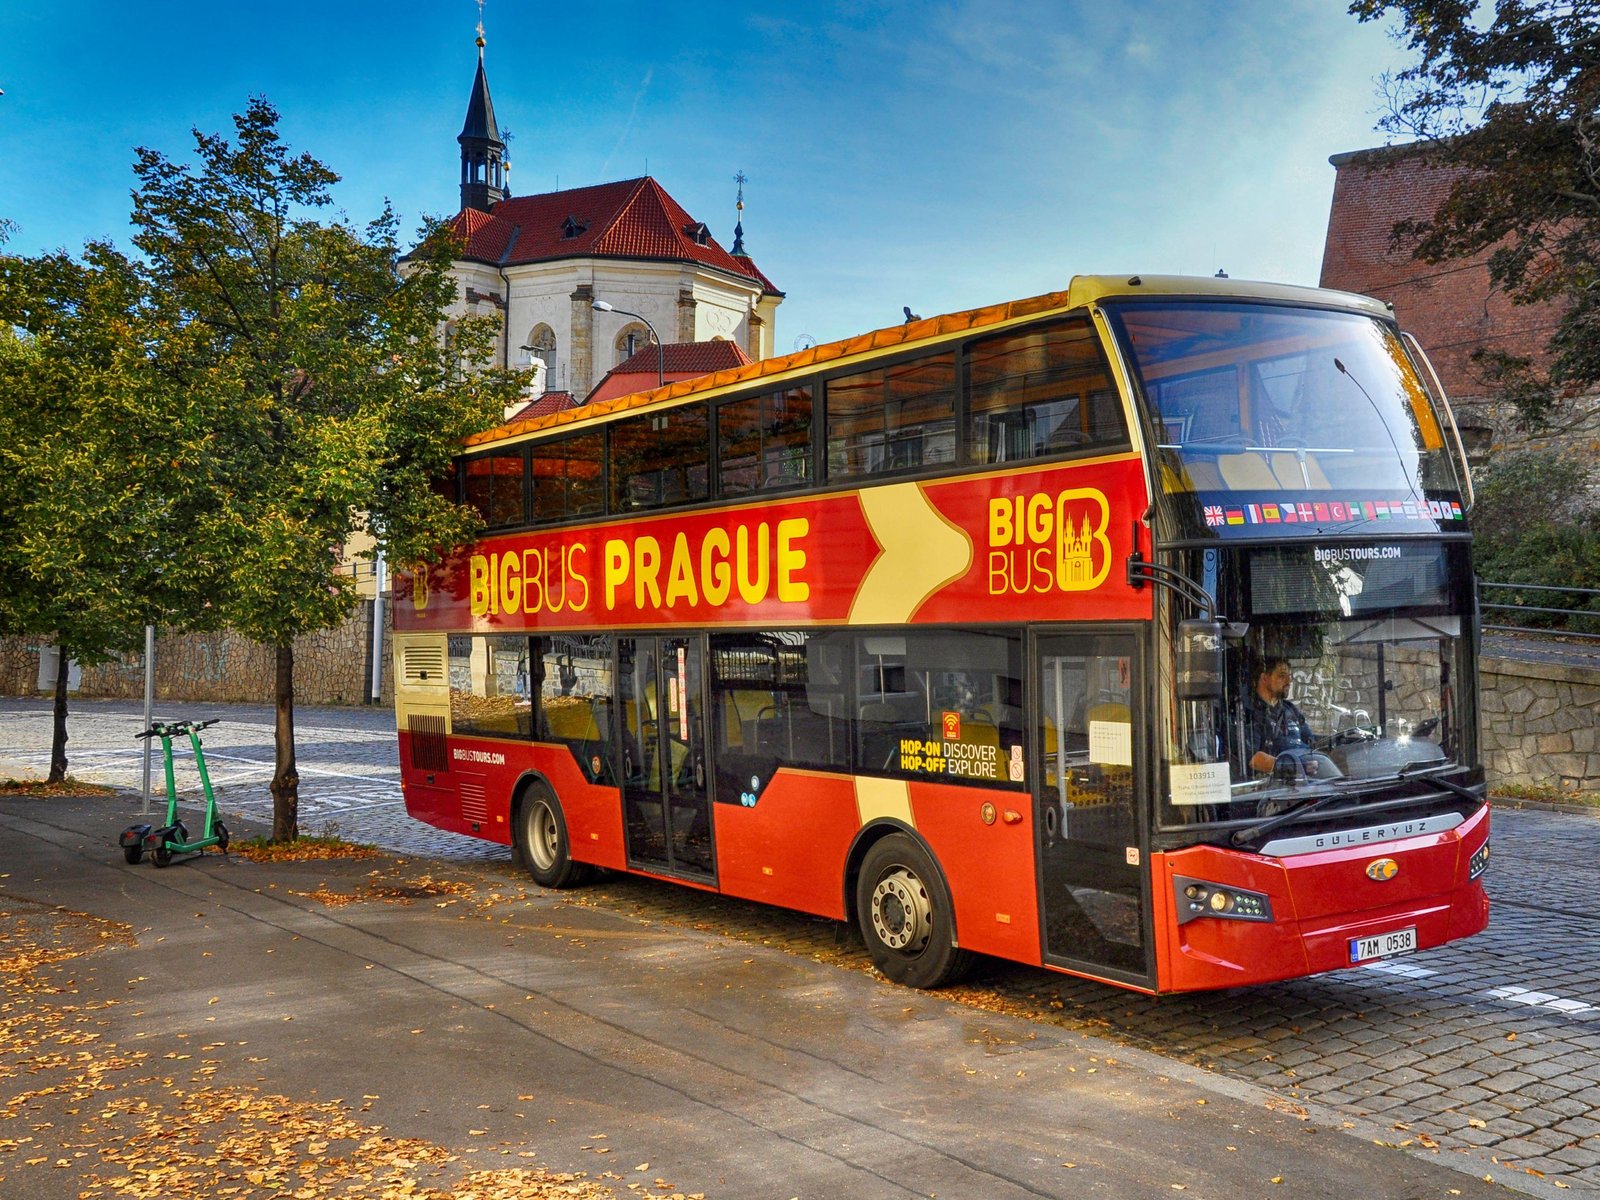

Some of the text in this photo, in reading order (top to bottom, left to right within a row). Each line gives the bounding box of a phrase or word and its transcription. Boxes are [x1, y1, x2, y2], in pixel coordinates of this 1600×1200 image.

[989, 493, 1054, 547] BIG
[1314, 546, 1401, 562] BIGBUSTOURS.COM
[470, 518, 810, 616] BIGBUS PRAGUE
[989, 548, 1053, 595] BUS
[453, 748, 506, 765] BIGBUSTOURS.COM
[900, 739, 996, 761] HOP-ON DISCOVER
[900, 755, 997, 778] HOP-OFF EXPLORE
[1189, 771, 1216, 780] 103913
[1360, 939, 1379, 958] 7AM
[1387, 932, 1411, 951] 0538
